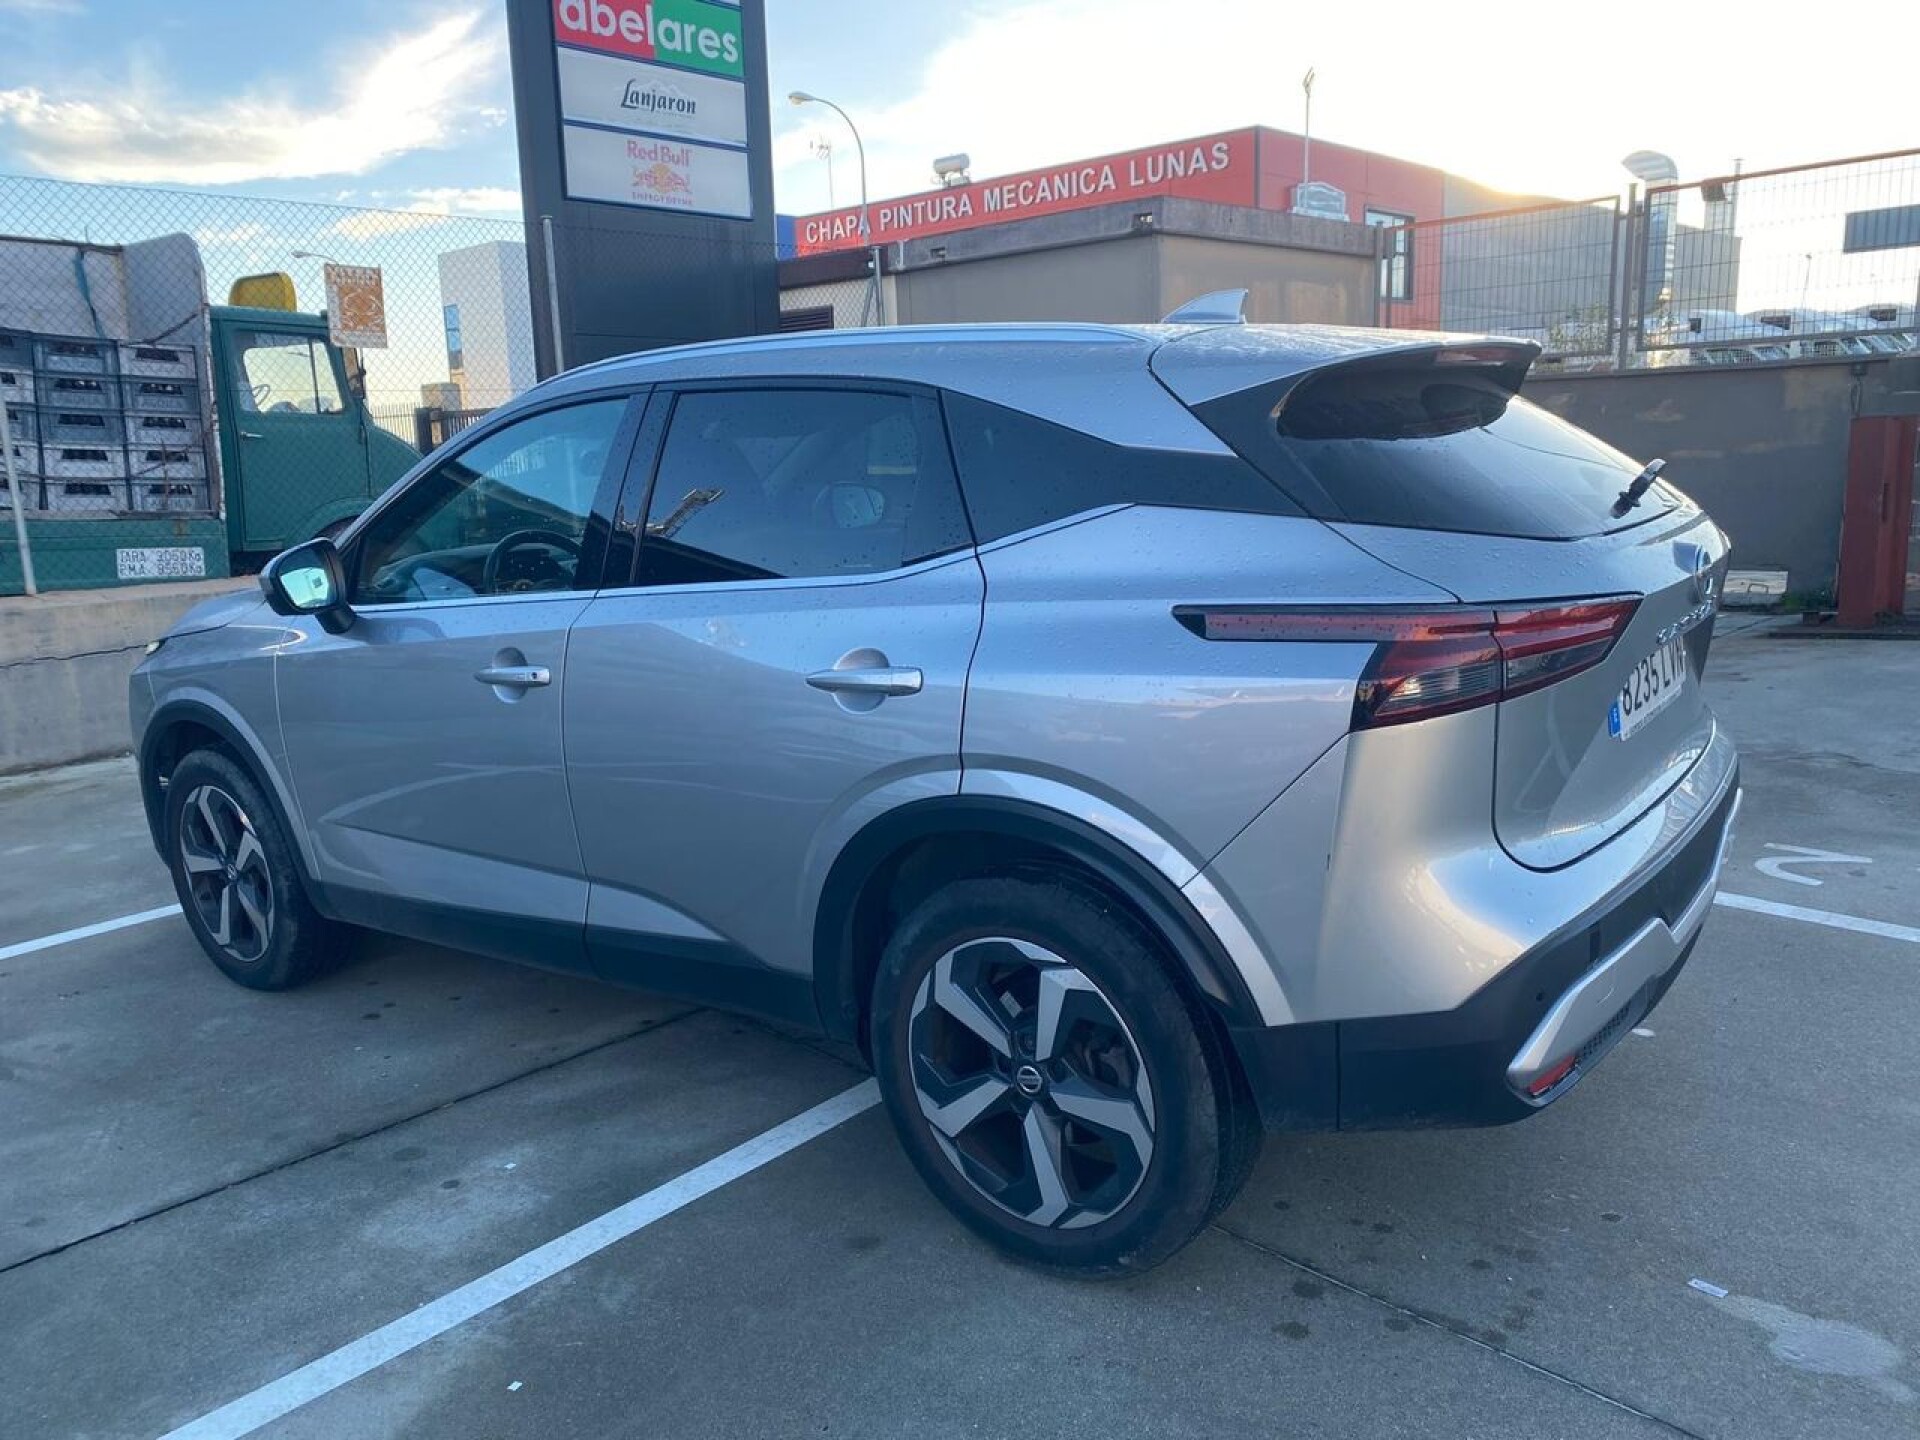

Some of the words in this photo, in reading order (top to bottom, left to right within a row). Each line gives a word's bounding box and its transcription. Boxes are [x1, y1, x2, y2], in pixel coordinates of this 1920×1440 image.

[558, 0, 739, 63] abelares
[620, 78, 697, 115] Lanjaron
[626, 140, 658, 162] Red
[660, 144, 691, 167] Bull
[806, 216, 872, 244] CHAPA
[880, 192, 973, 231] PINTURA
[983, 164, 1116, 214] MECANICA
[1129, 142, 1230, 187] LUNAS
